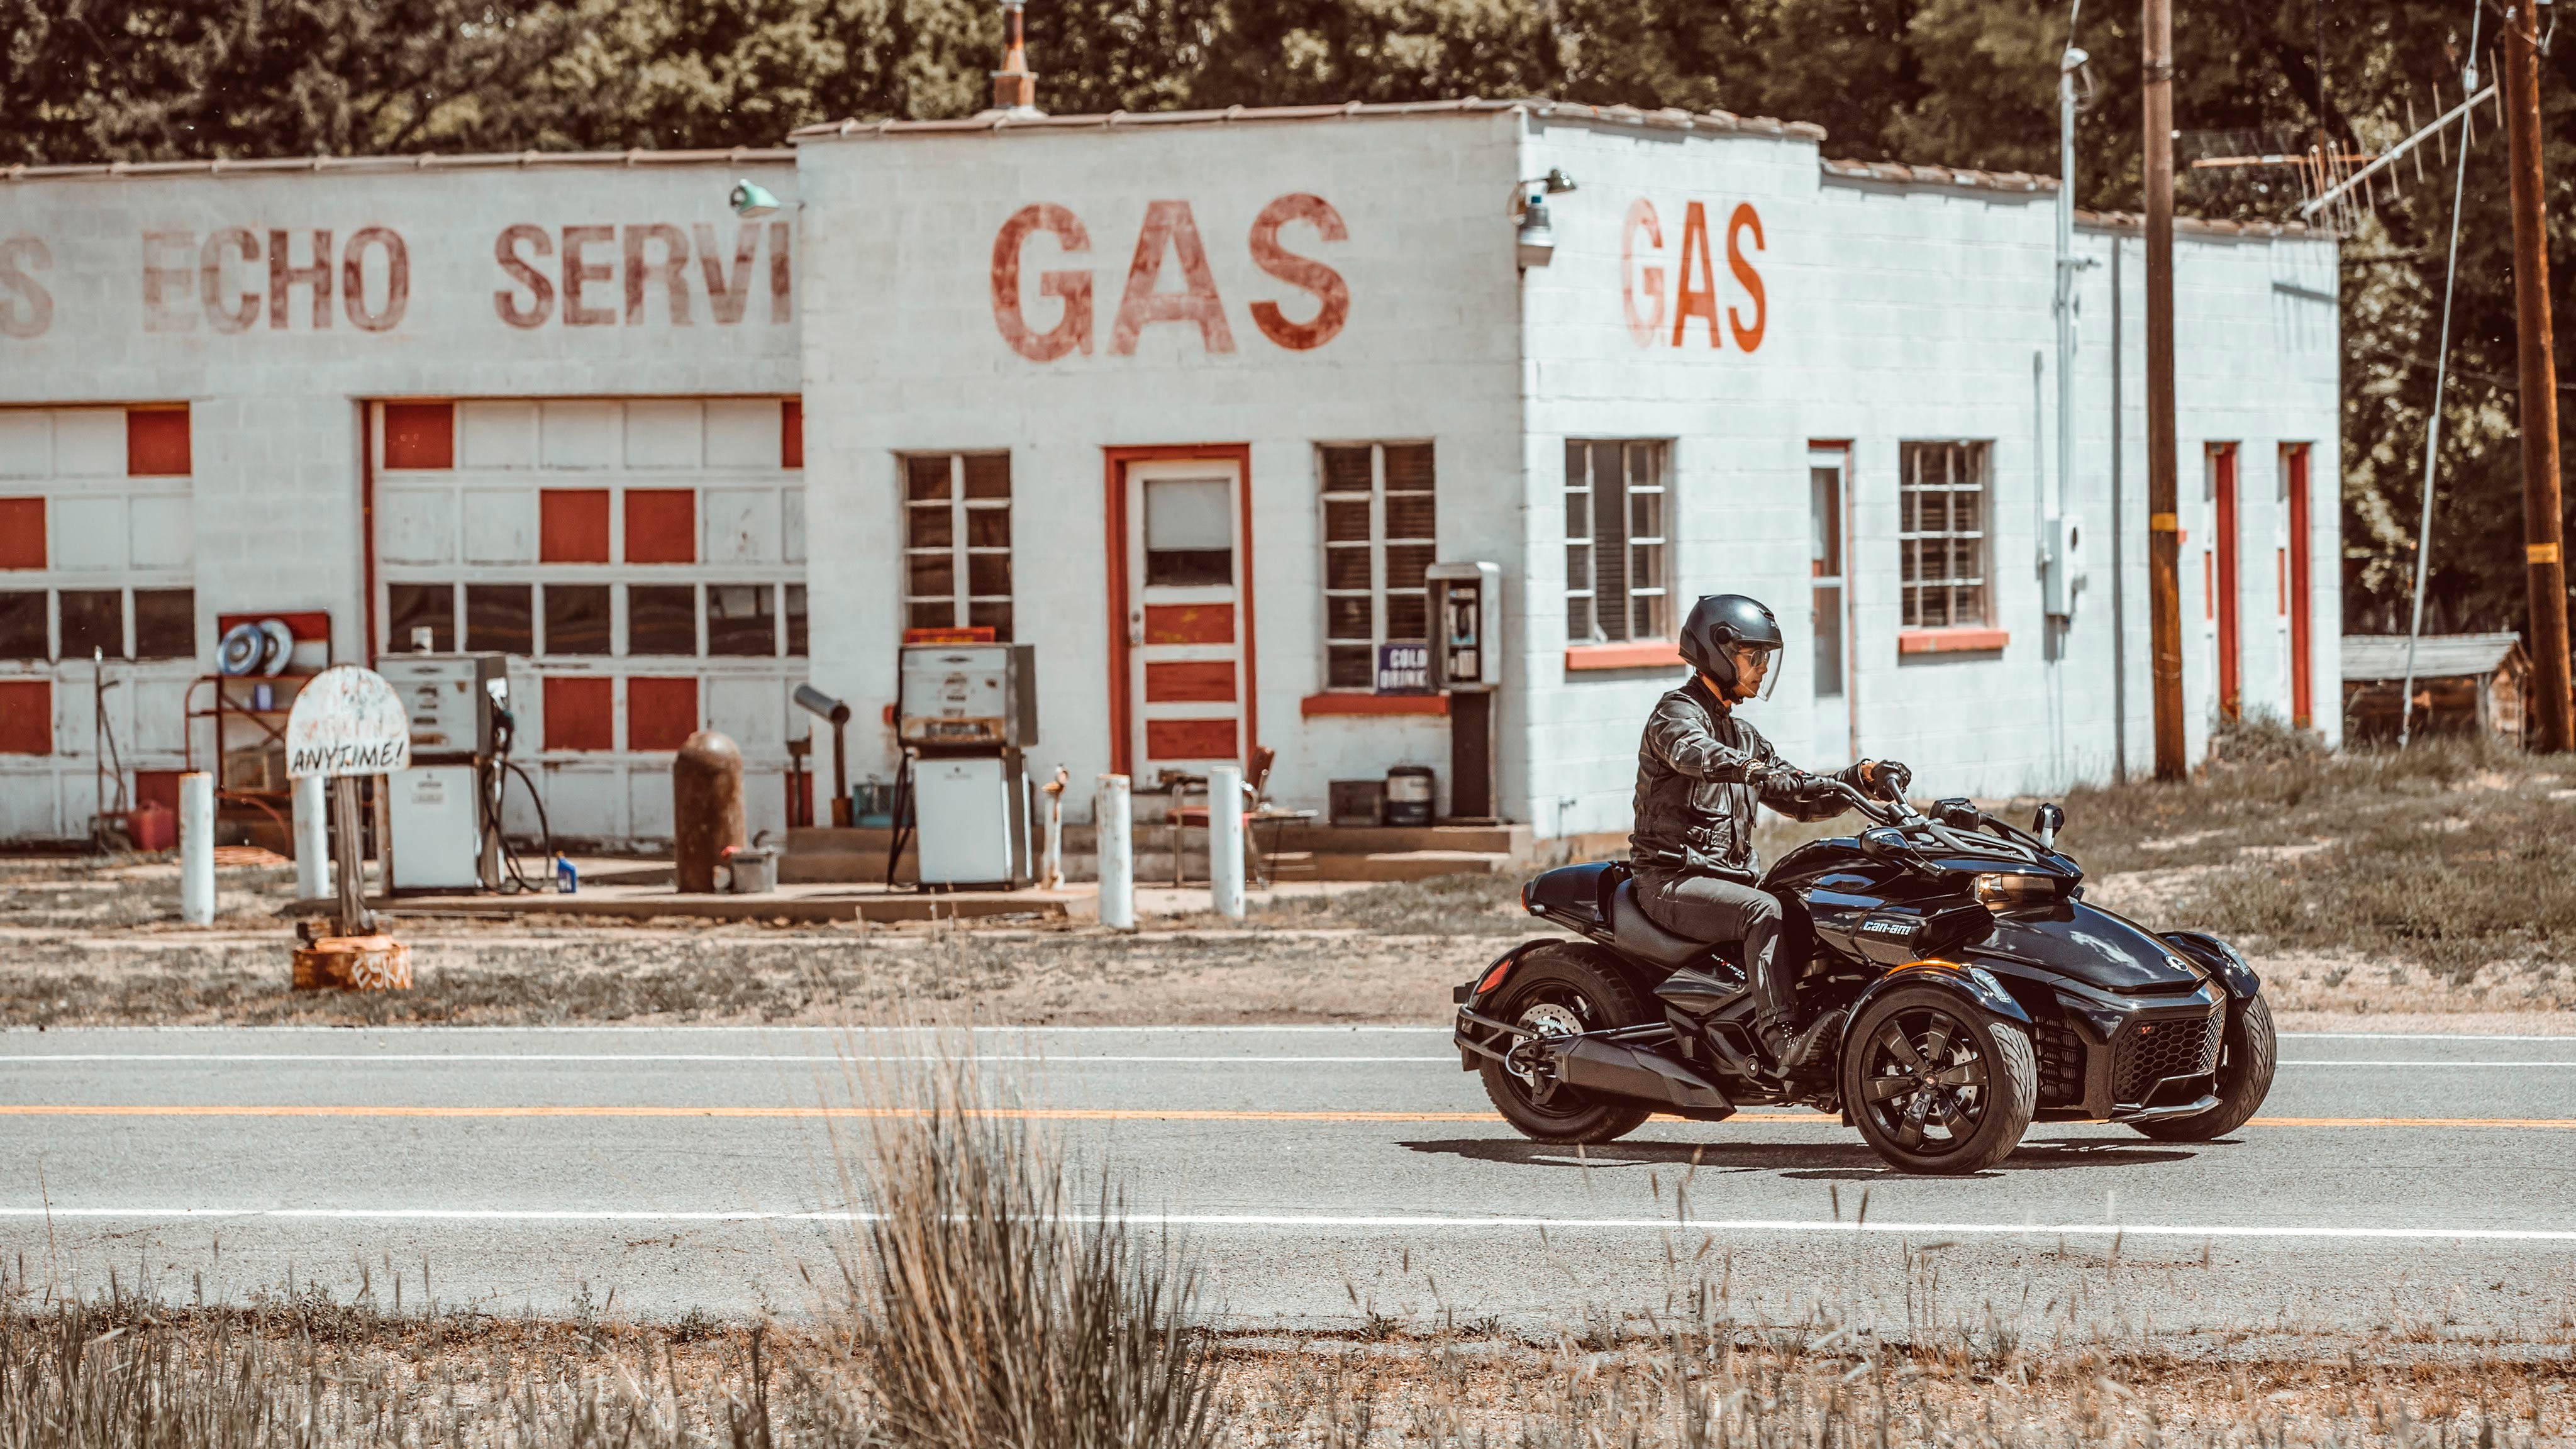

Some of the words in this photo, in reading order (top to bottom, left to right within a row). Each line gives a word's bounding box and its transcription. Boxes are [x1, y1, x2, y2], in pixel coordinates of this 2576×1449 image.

[142, 225, 411, 333] ECHO
[494, 221, 791, 330] SERVI
[991, 192, 1350, 363] GAS
[1622, 198, 1767, 353] GAS
[1390, 648, 1428, 668] COLD
[292, 740, 404, 772] ANYTIME!
[1863, 921, 1912, 935] can-am
